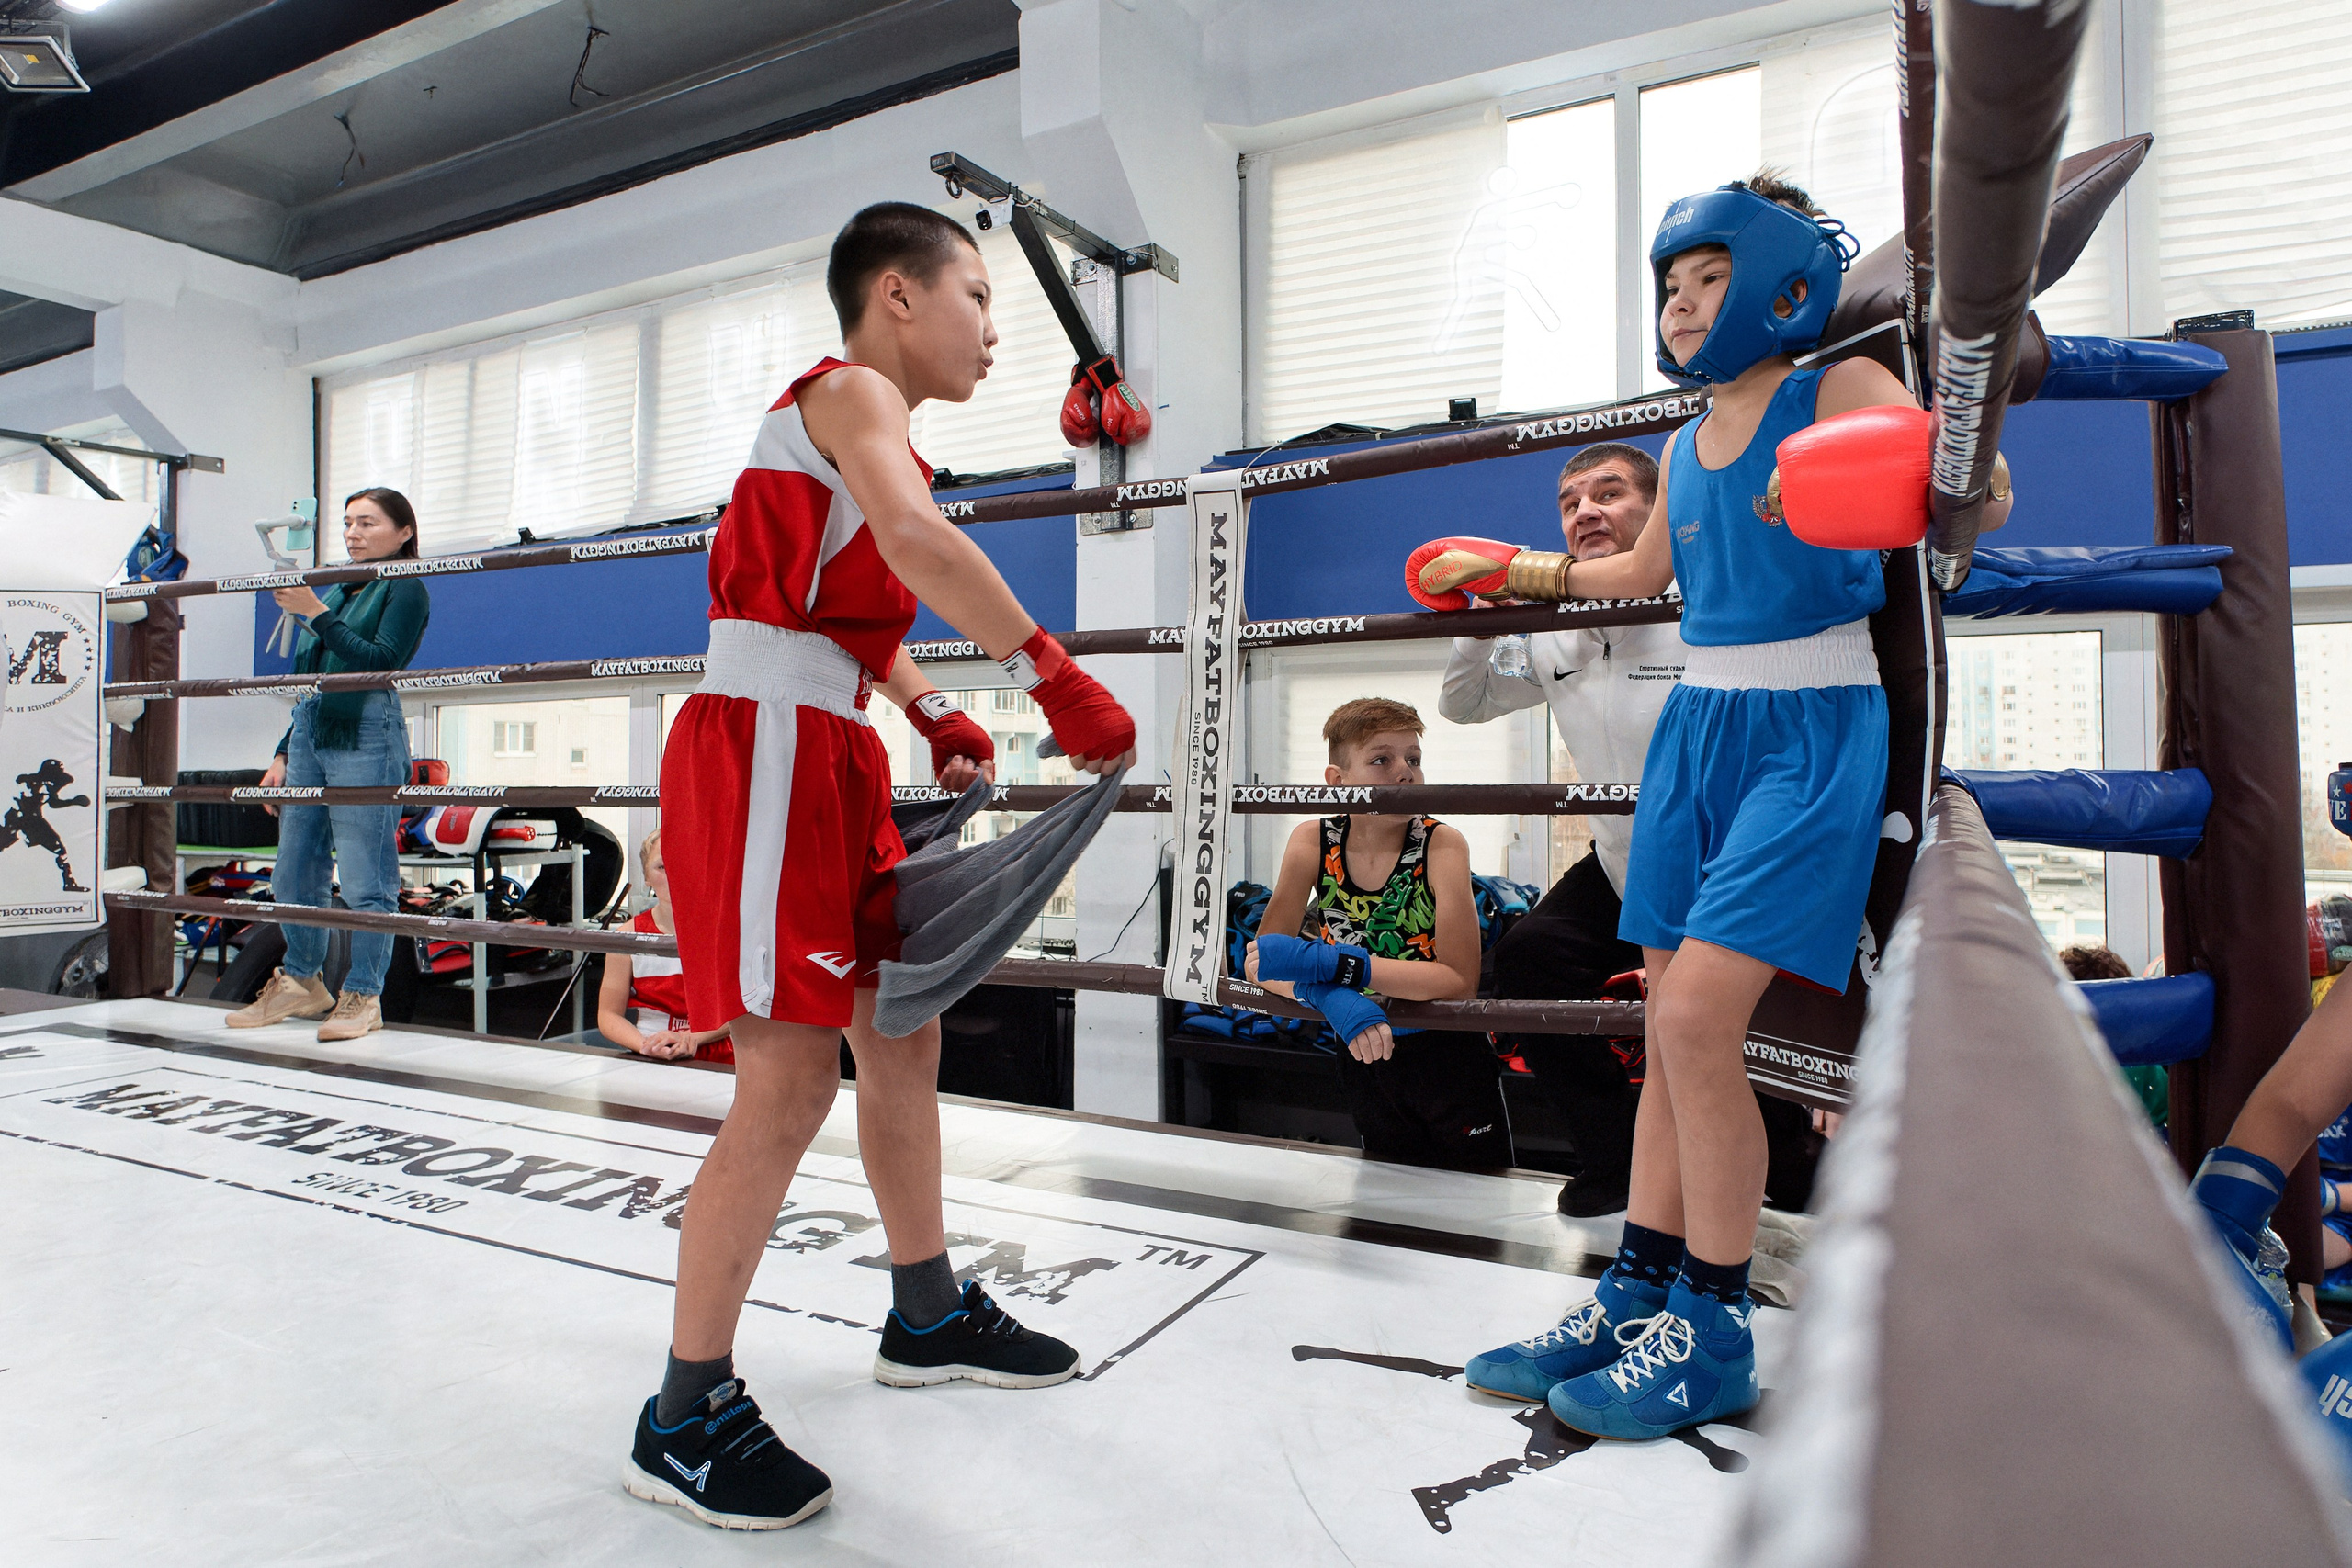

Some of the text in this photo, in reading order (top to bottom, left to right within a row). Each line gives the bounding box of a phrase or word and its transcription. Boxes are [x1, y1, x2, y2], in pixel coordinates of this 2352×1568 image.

[1516, 396, 1713, 442] TBOXINGGYM
[571, 533, 701, 559] MAYFATBOXINGGYM
[377, 557, 483, 577] MAYFATBOXINGGYM
[1421, 561, 1463, 591] HYBRID
[216, 574, 306, 593] MAYFATBOXINGGYM
[7, 599, 88, 635] BOXING GYM
[591, 658, 707, 678] MAYFATBOXINGGY
[1185, 513, 1227, 984] MAYFATBOXINGGYM
[1191, 712, 1202, 785] SINCE 1980
[1229, 983, 1264, 997] SINCE 1980
[1744, 1040, 1860, 1082] AYFATBOXING
[1798, 1070, 1815, 1081] SINCE
[292, 1172, 468, 1213] SINCE 1980
[1136, 1244, 1213, 1270] TM
